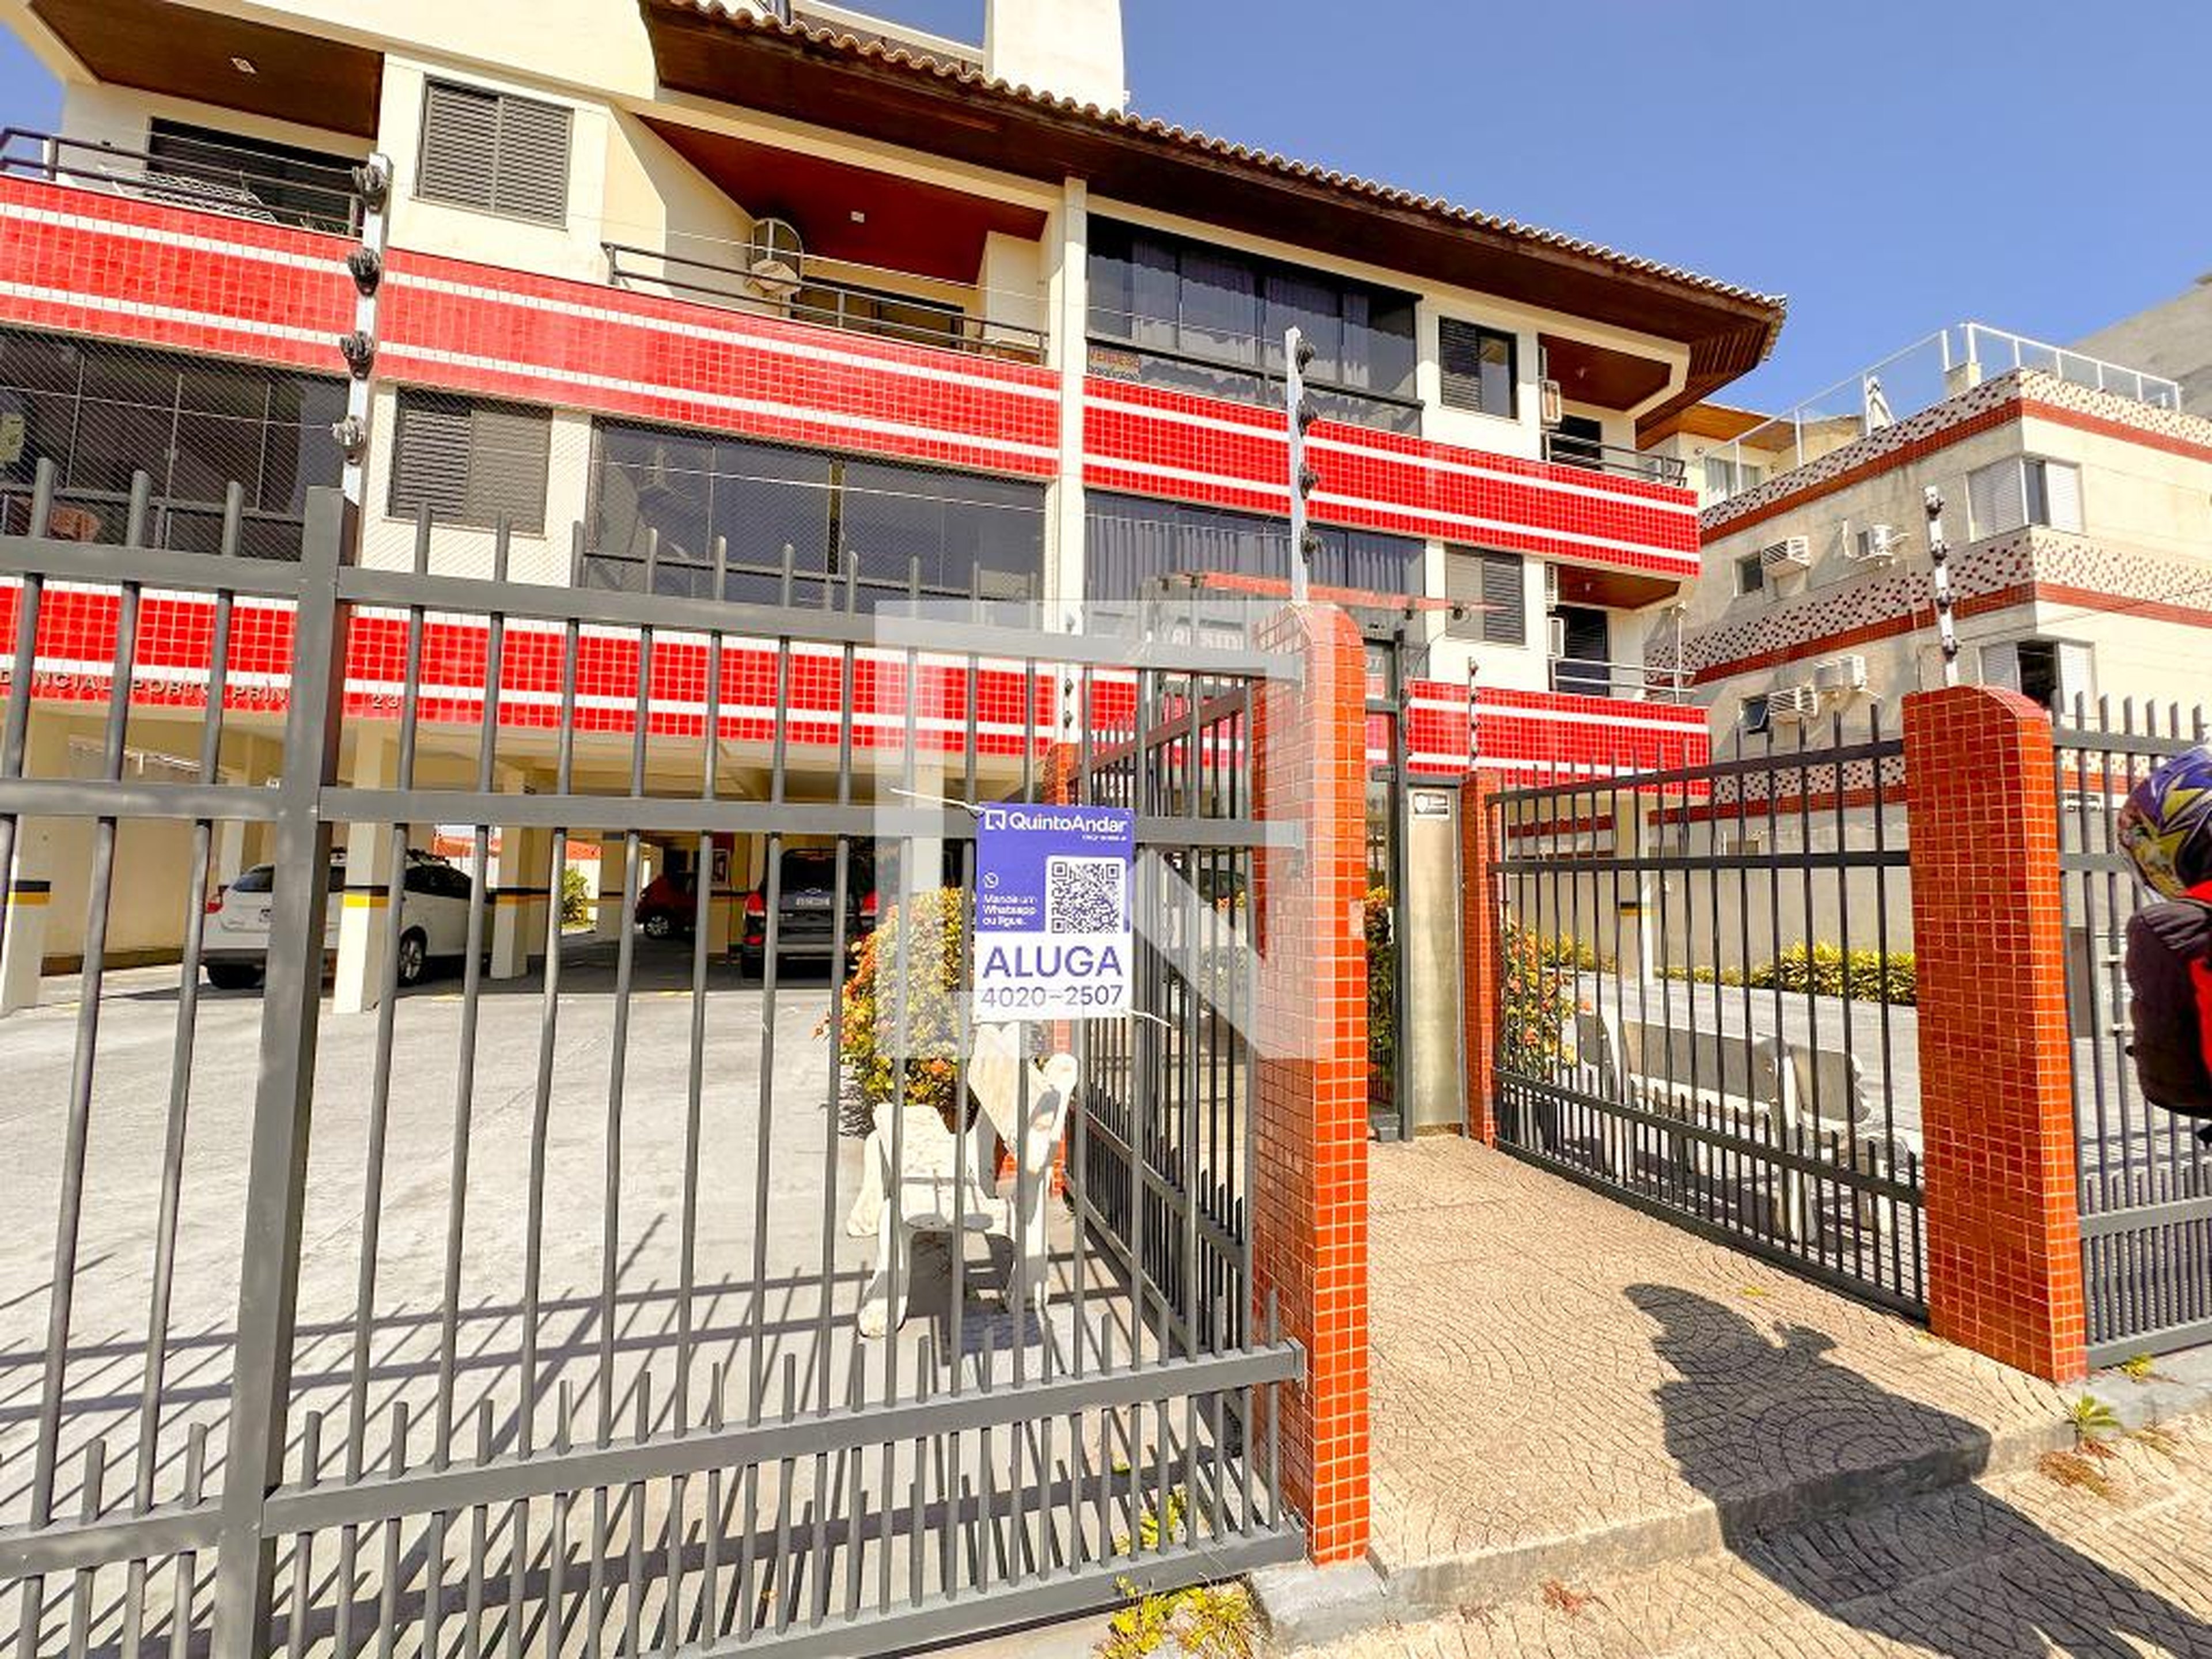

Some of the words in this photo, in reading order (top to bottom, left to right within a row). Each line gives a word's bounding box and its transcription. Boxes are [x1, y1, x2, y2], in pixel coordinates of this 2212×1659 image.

[1009, 812, 1127, 834] QuintoAndar
[983, 946, 1123, 978] ALUGA
[980, 984, 1123, 1007] 4020-2507
